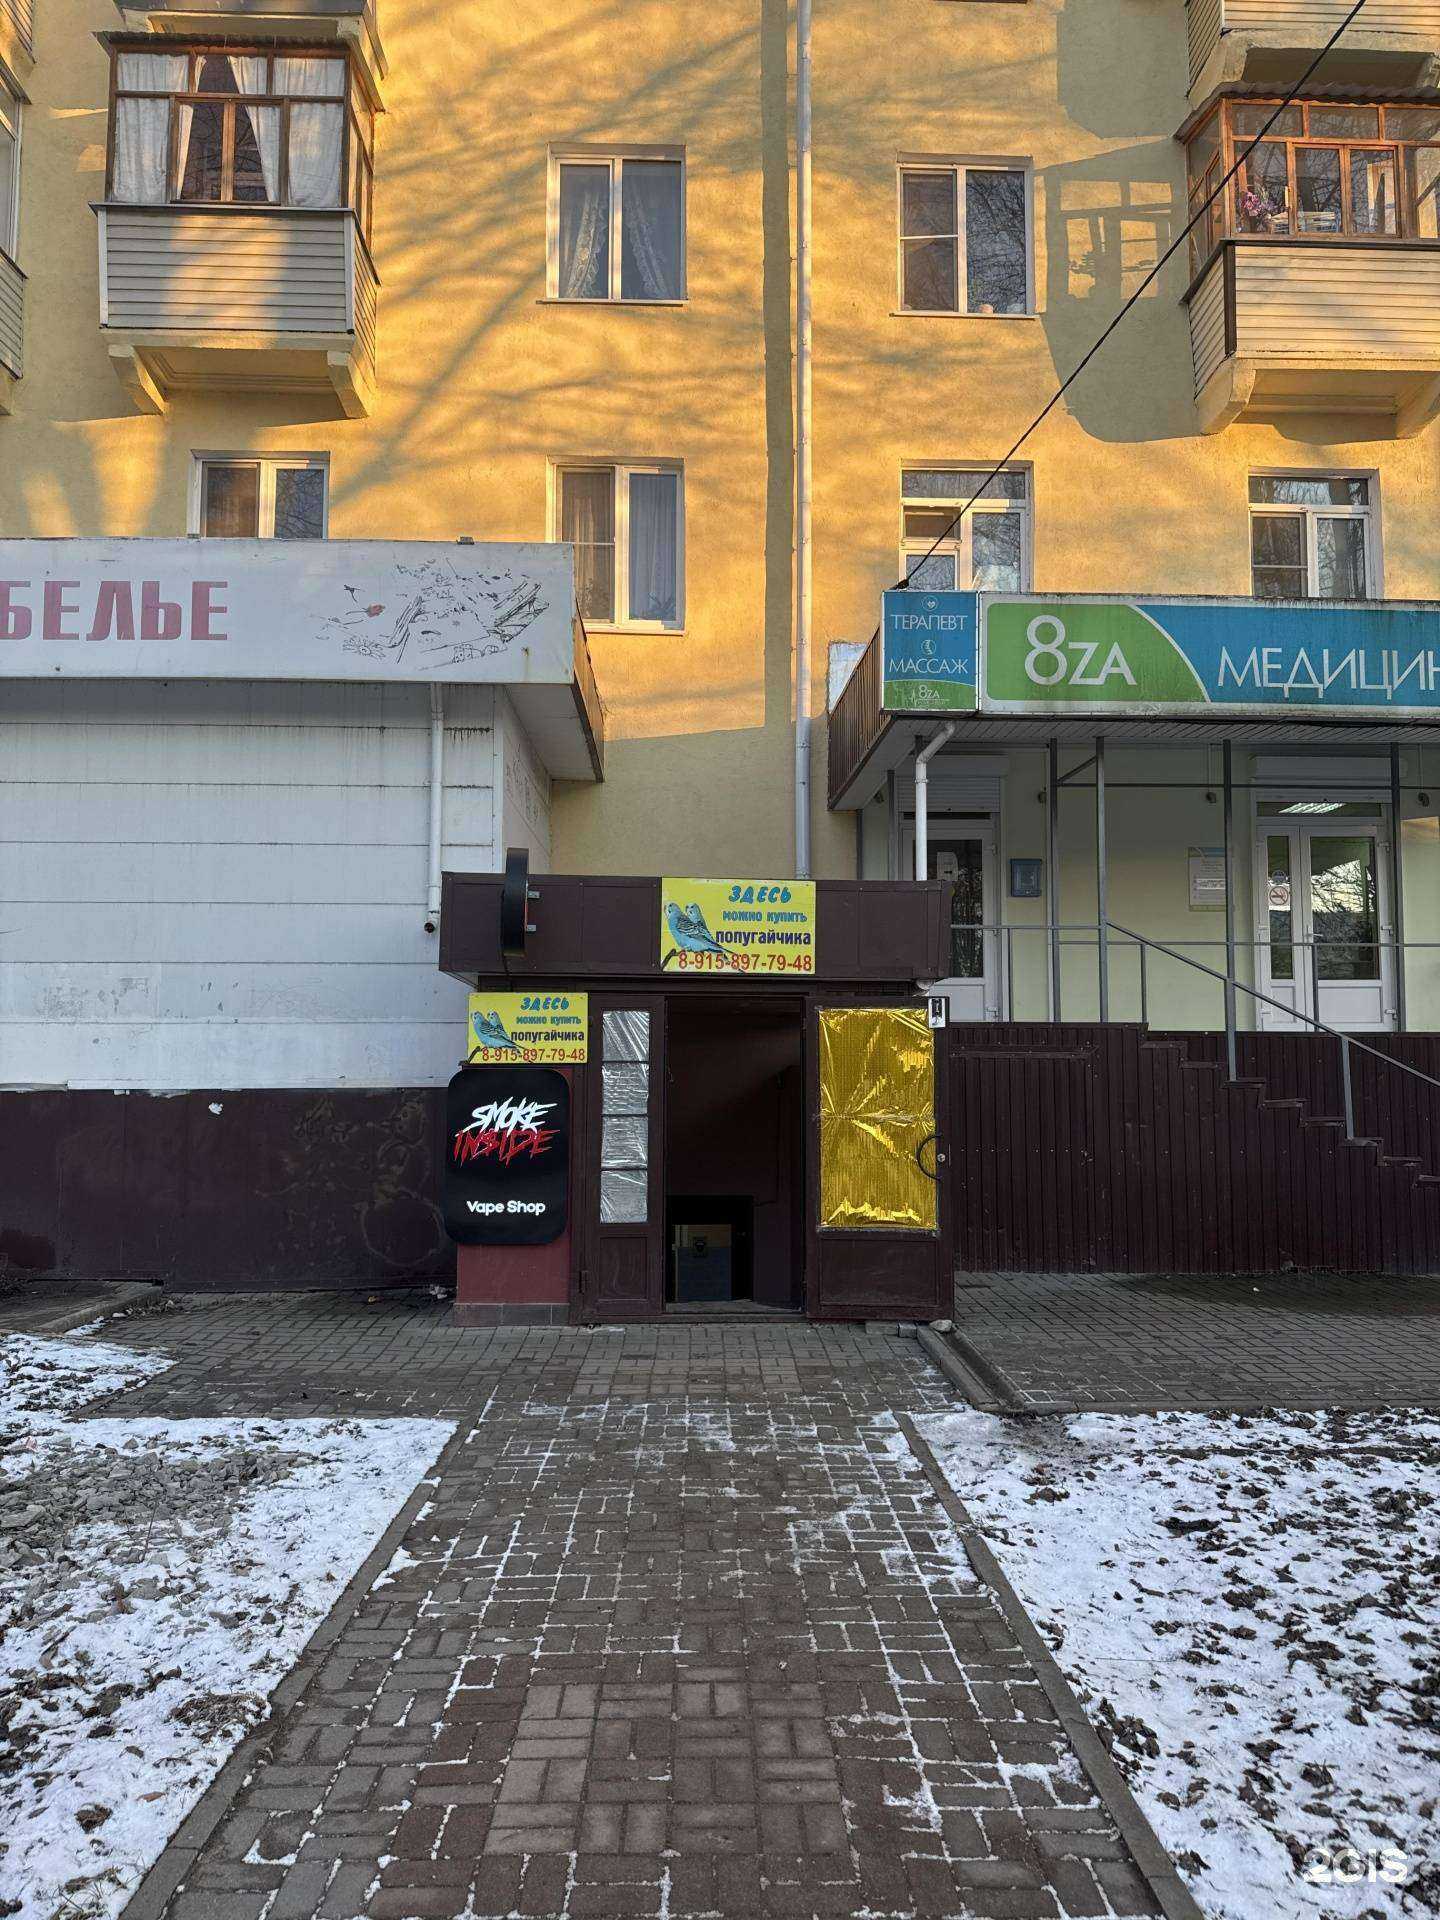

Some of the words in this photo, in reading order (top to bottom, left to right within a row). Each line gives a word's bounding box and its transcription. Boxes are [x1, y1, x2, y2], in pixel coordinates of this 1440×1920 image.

[0, 580, 228, 641] БЕЛЬЕ
[890, 613, 968, 631] ТЕРАПЕВТ
[1024, 614, 1138, 686] 8ZA
[888, 658, 969, 674] МАССАЖ
[728, 885, 792, 904] ЗДЕСЬ
[722, 910, 762, 922] можно
[766, 911, 808, 924] купить
[715, 929, 811, 946] попугайчика
[678, 952, 812, 972] 8-915-897-79-48
[520, 997, 570, 1011] ЗДЕСЬ
[516, 1016, 547, 1025] можно
[550, 1017, 581, 1026] купить
[511, 1030, 585, 1044] попугайчика
[482, 1048, 585, 1061] 8-915-897-79-48
[455, 1096, 558, 1138] SMOKE
[466, 1200, 504, 1216] Vape
[507, 1200, 546, 1216] Shop
